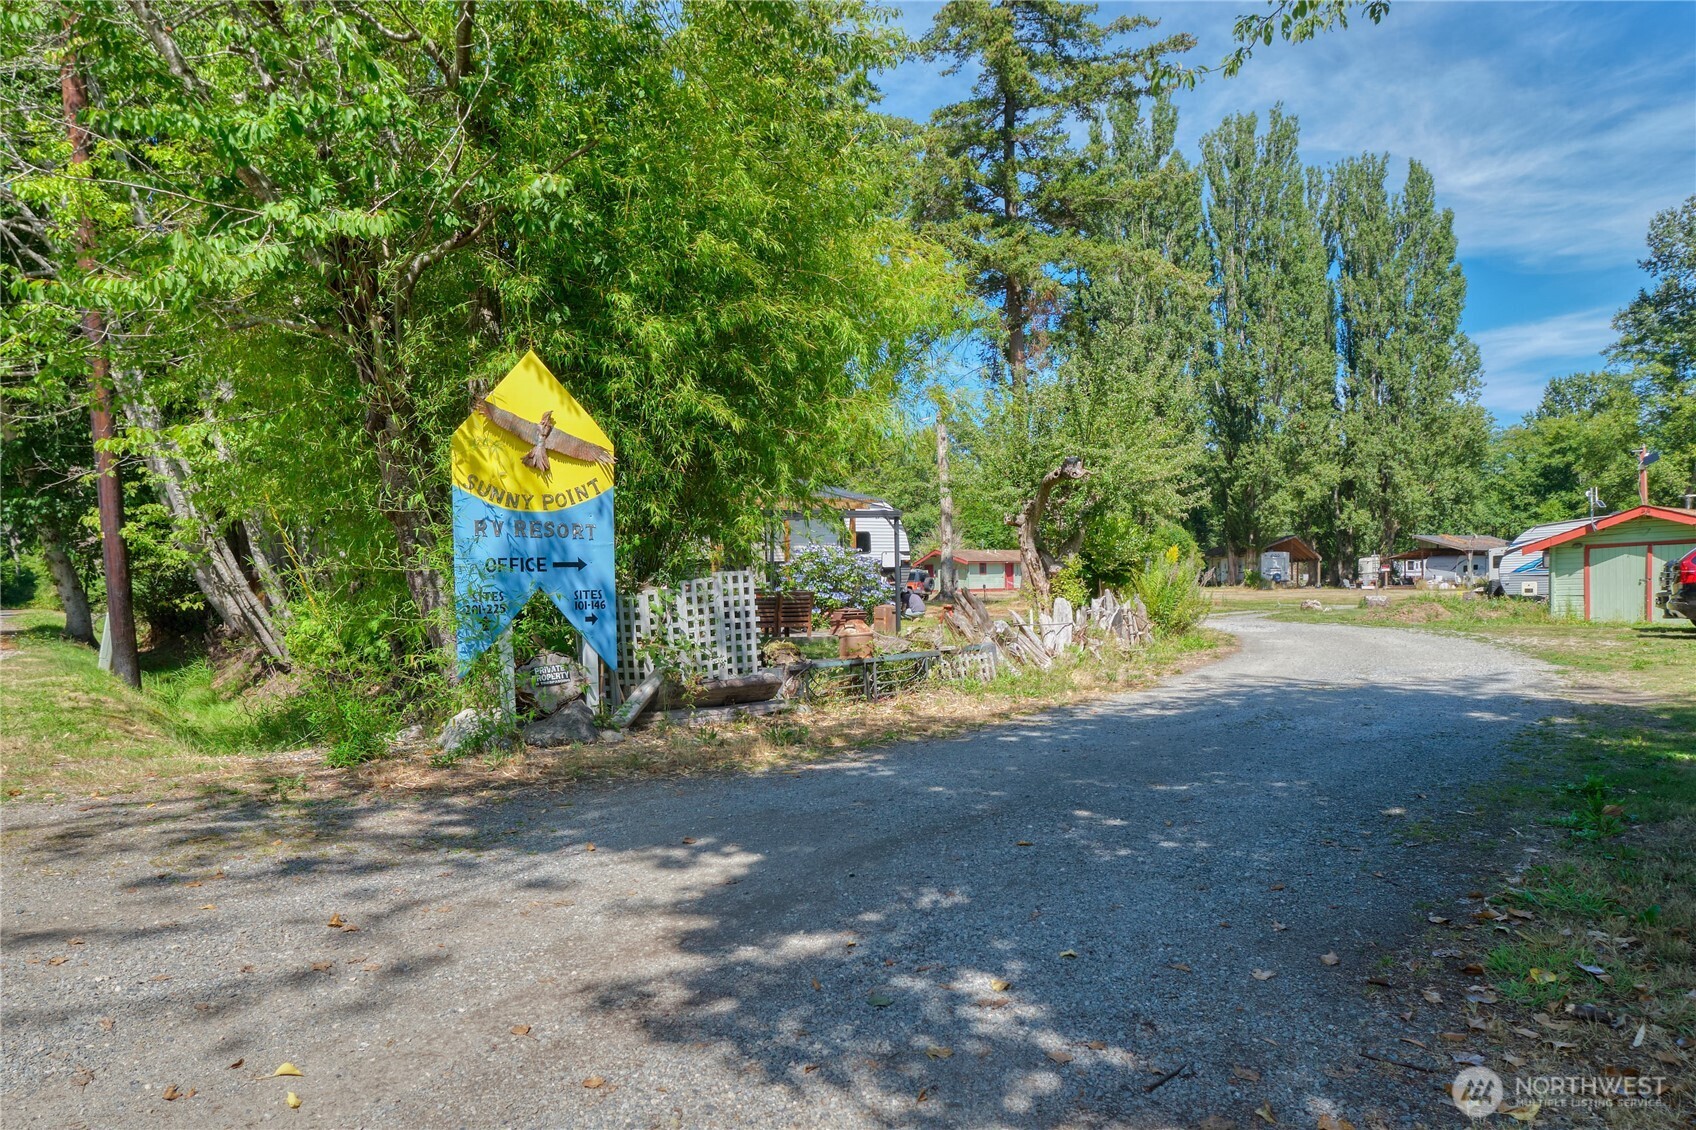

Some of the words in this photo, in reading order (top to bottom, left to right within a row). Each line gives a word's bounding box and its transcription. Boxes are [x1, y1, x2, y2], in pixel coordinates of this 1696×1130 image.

[463, 473, 535, 511] SUNNY
[542, 477, 602, 511] POINT
[474, 519, 504, 538] RV
[514, 518, 597, 541] RESORT
[485, 557, 548, 573] OFFICE
[471, 591, 504, 602] SITES
[574, 589, 602, 600] SITES
[574, 600, 606, 610] 101-146
[534, 664, 566, 676] PRIVATE
[532, 671, 569, 682] ROPERTY
